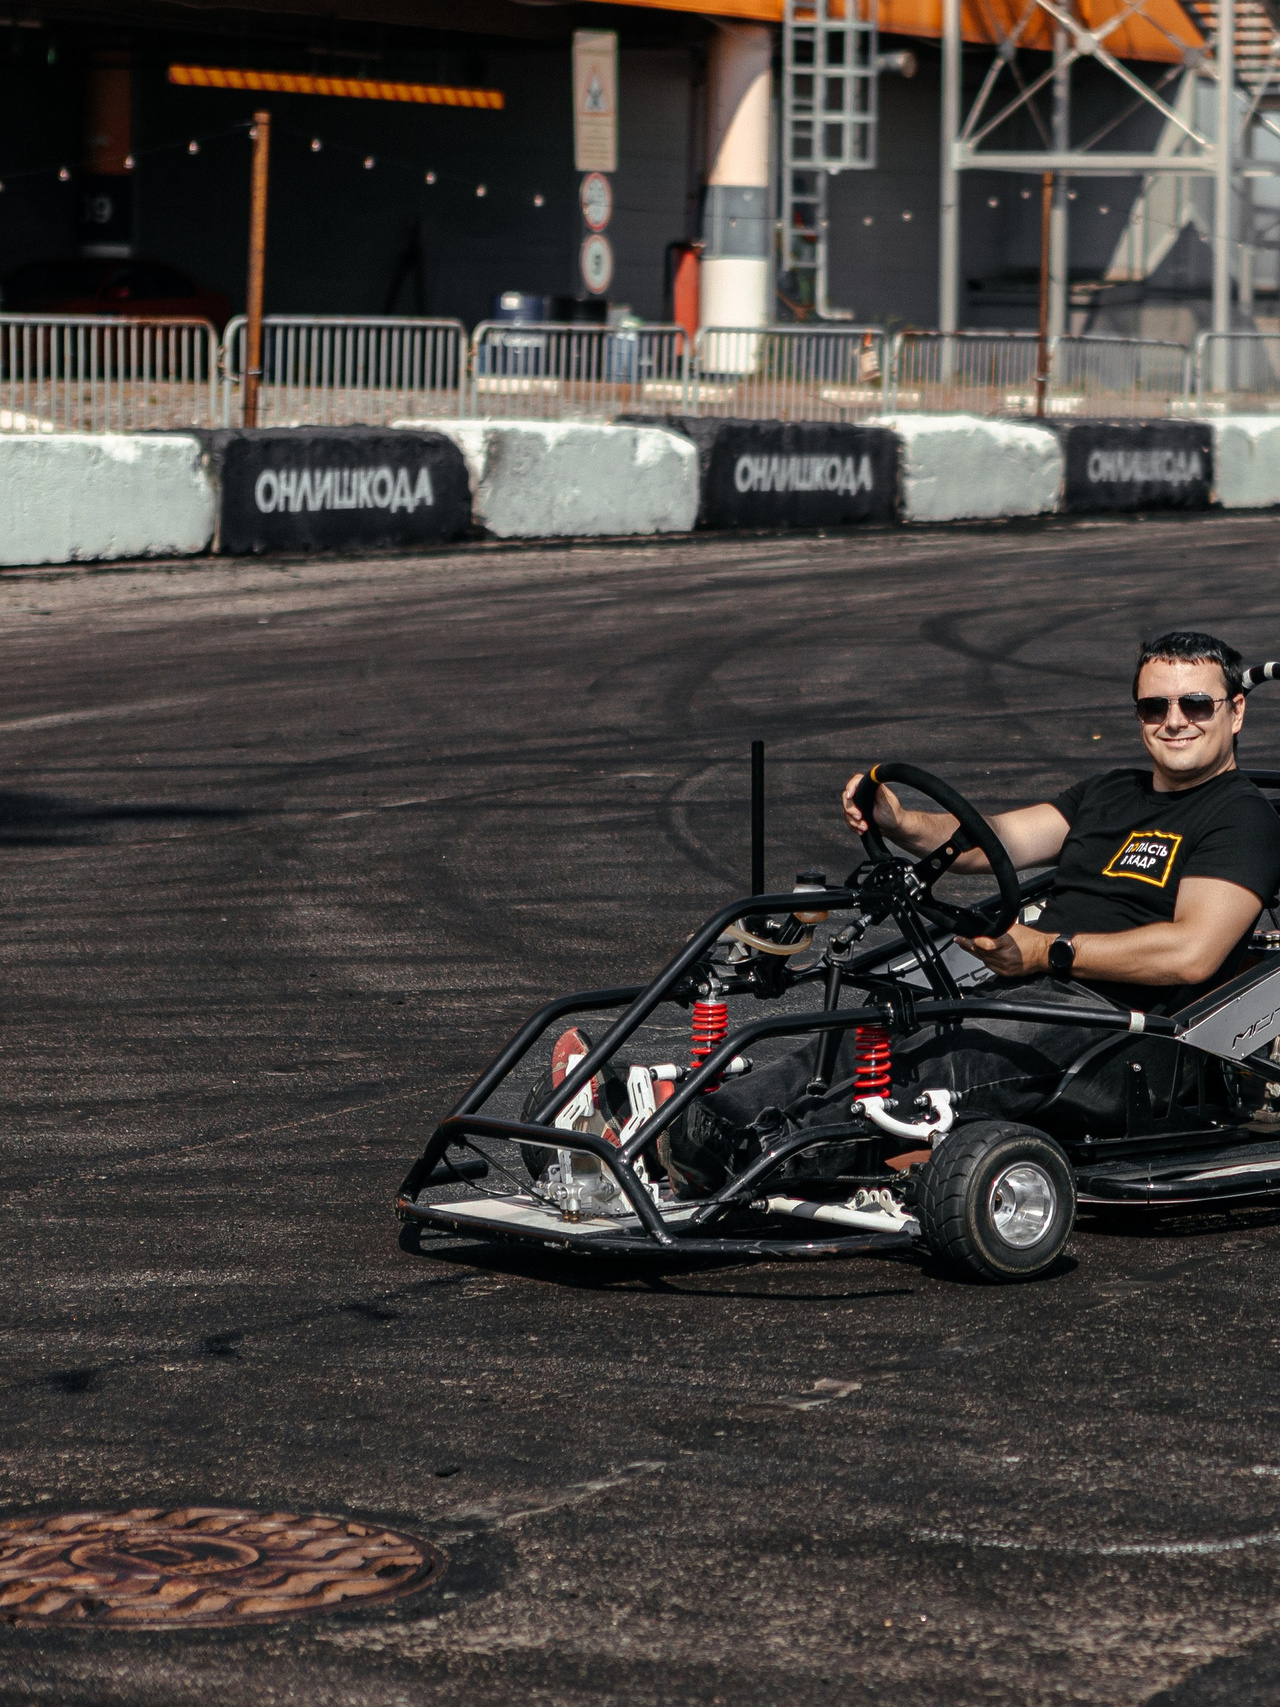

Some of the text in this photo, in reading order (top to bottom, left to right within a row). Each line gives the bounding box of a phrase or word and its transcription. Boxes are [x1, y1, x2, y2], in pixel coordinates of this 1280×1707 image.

[733, 453, 873, 496] ОНЛИШКОДА
[254, 465, 434, 514] ОНЛИШКОДА
[1125, 842, 1168, 857] ПОПАСТЬ
[1126, 854, 1157, 869] КАДР
